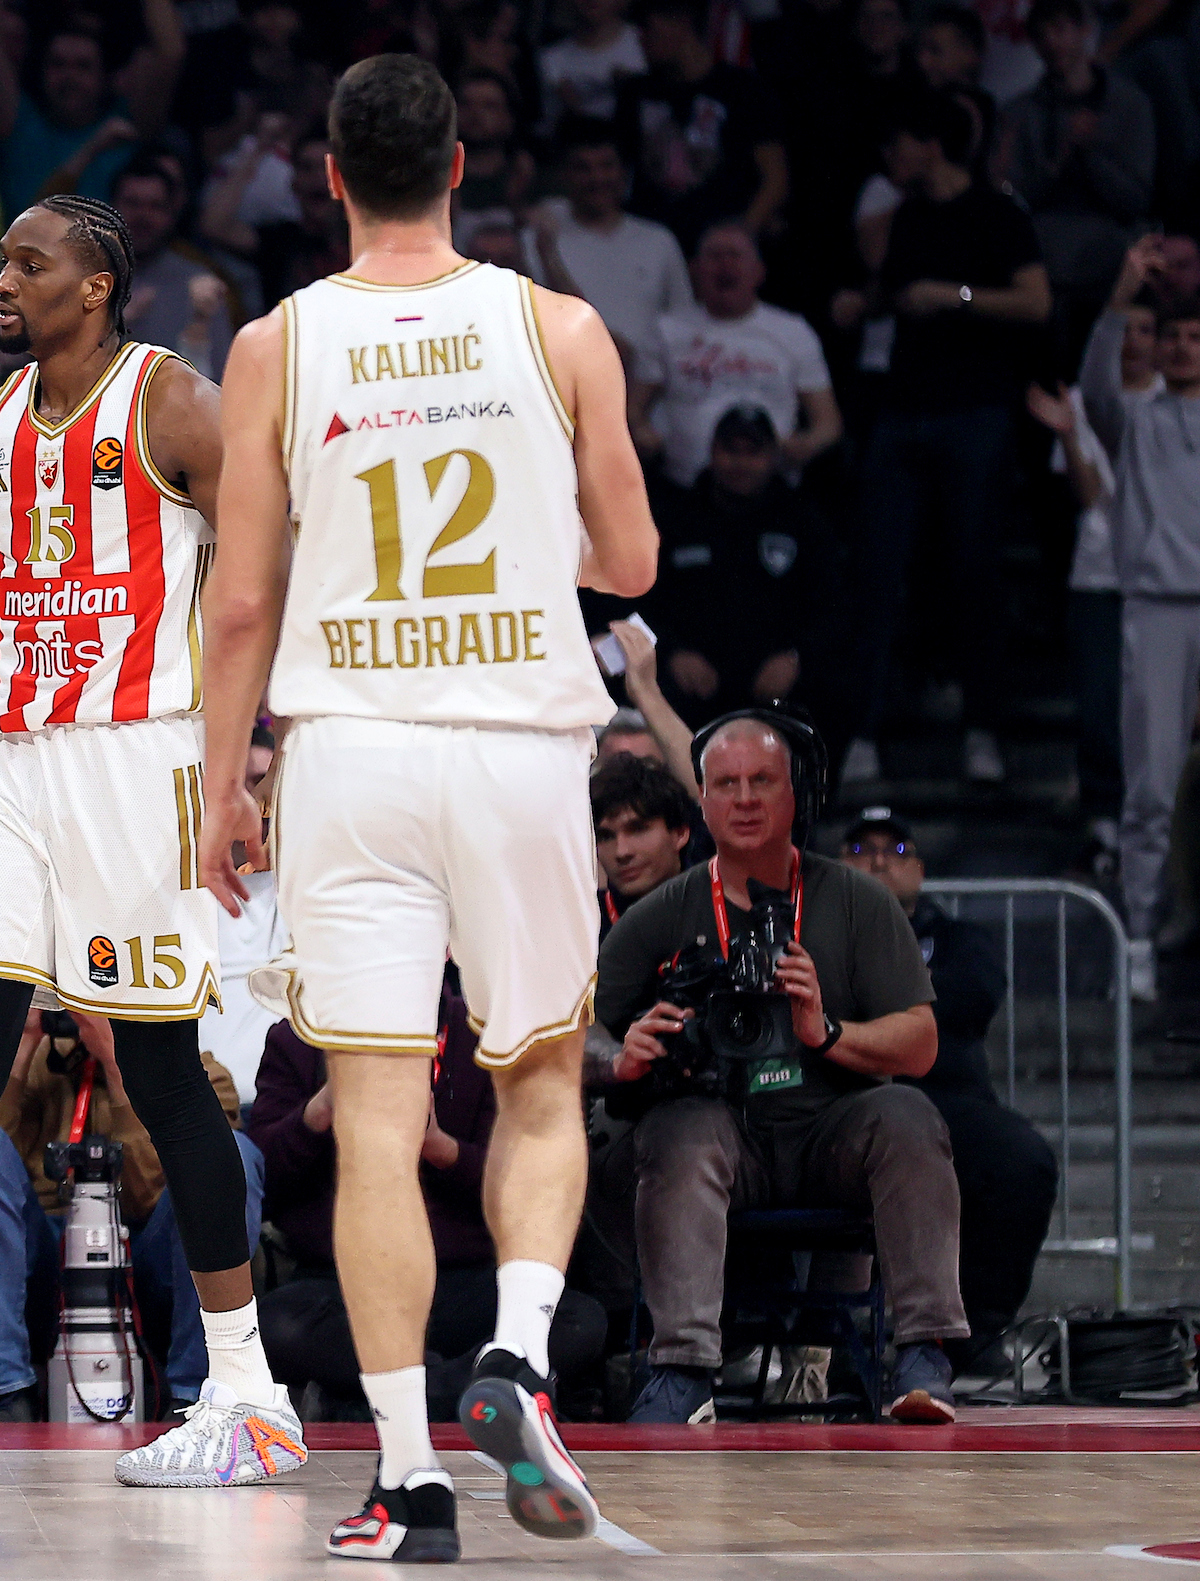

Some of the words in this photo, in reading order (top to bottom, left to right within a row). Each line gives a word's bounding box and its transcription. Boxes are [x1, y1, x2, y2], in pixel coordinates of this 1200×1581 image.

[348, 324, 483, 384] KALINIĆ
[23, 504, 76, 565] 15
[353, 448, 497, 602] 12
[4, 580, 128, 617] meridian
[13, 631, 104, 677] mts
[319, 609, 547, 669] BELGRADE
[123, 933, 187, 990] 15
